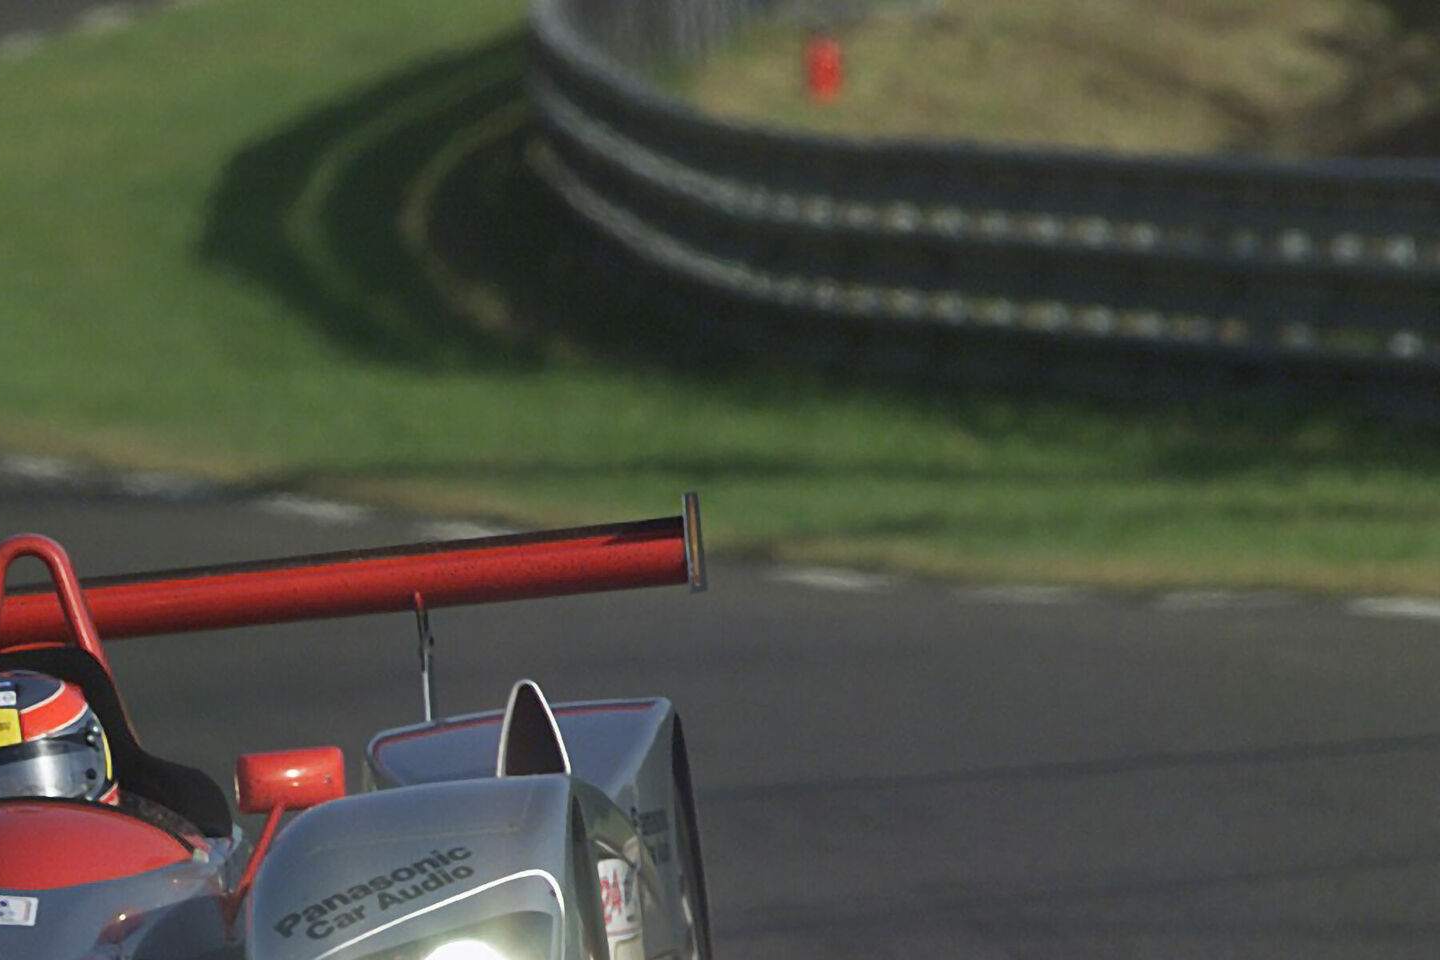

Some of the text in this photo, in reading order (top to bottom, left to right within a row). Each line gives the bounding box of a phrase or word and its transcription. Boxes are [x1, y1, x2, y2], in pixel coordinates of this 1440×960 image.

[273, 846, 472, 939] Panasonic
[306, 865, 474, 939] Car Audio
